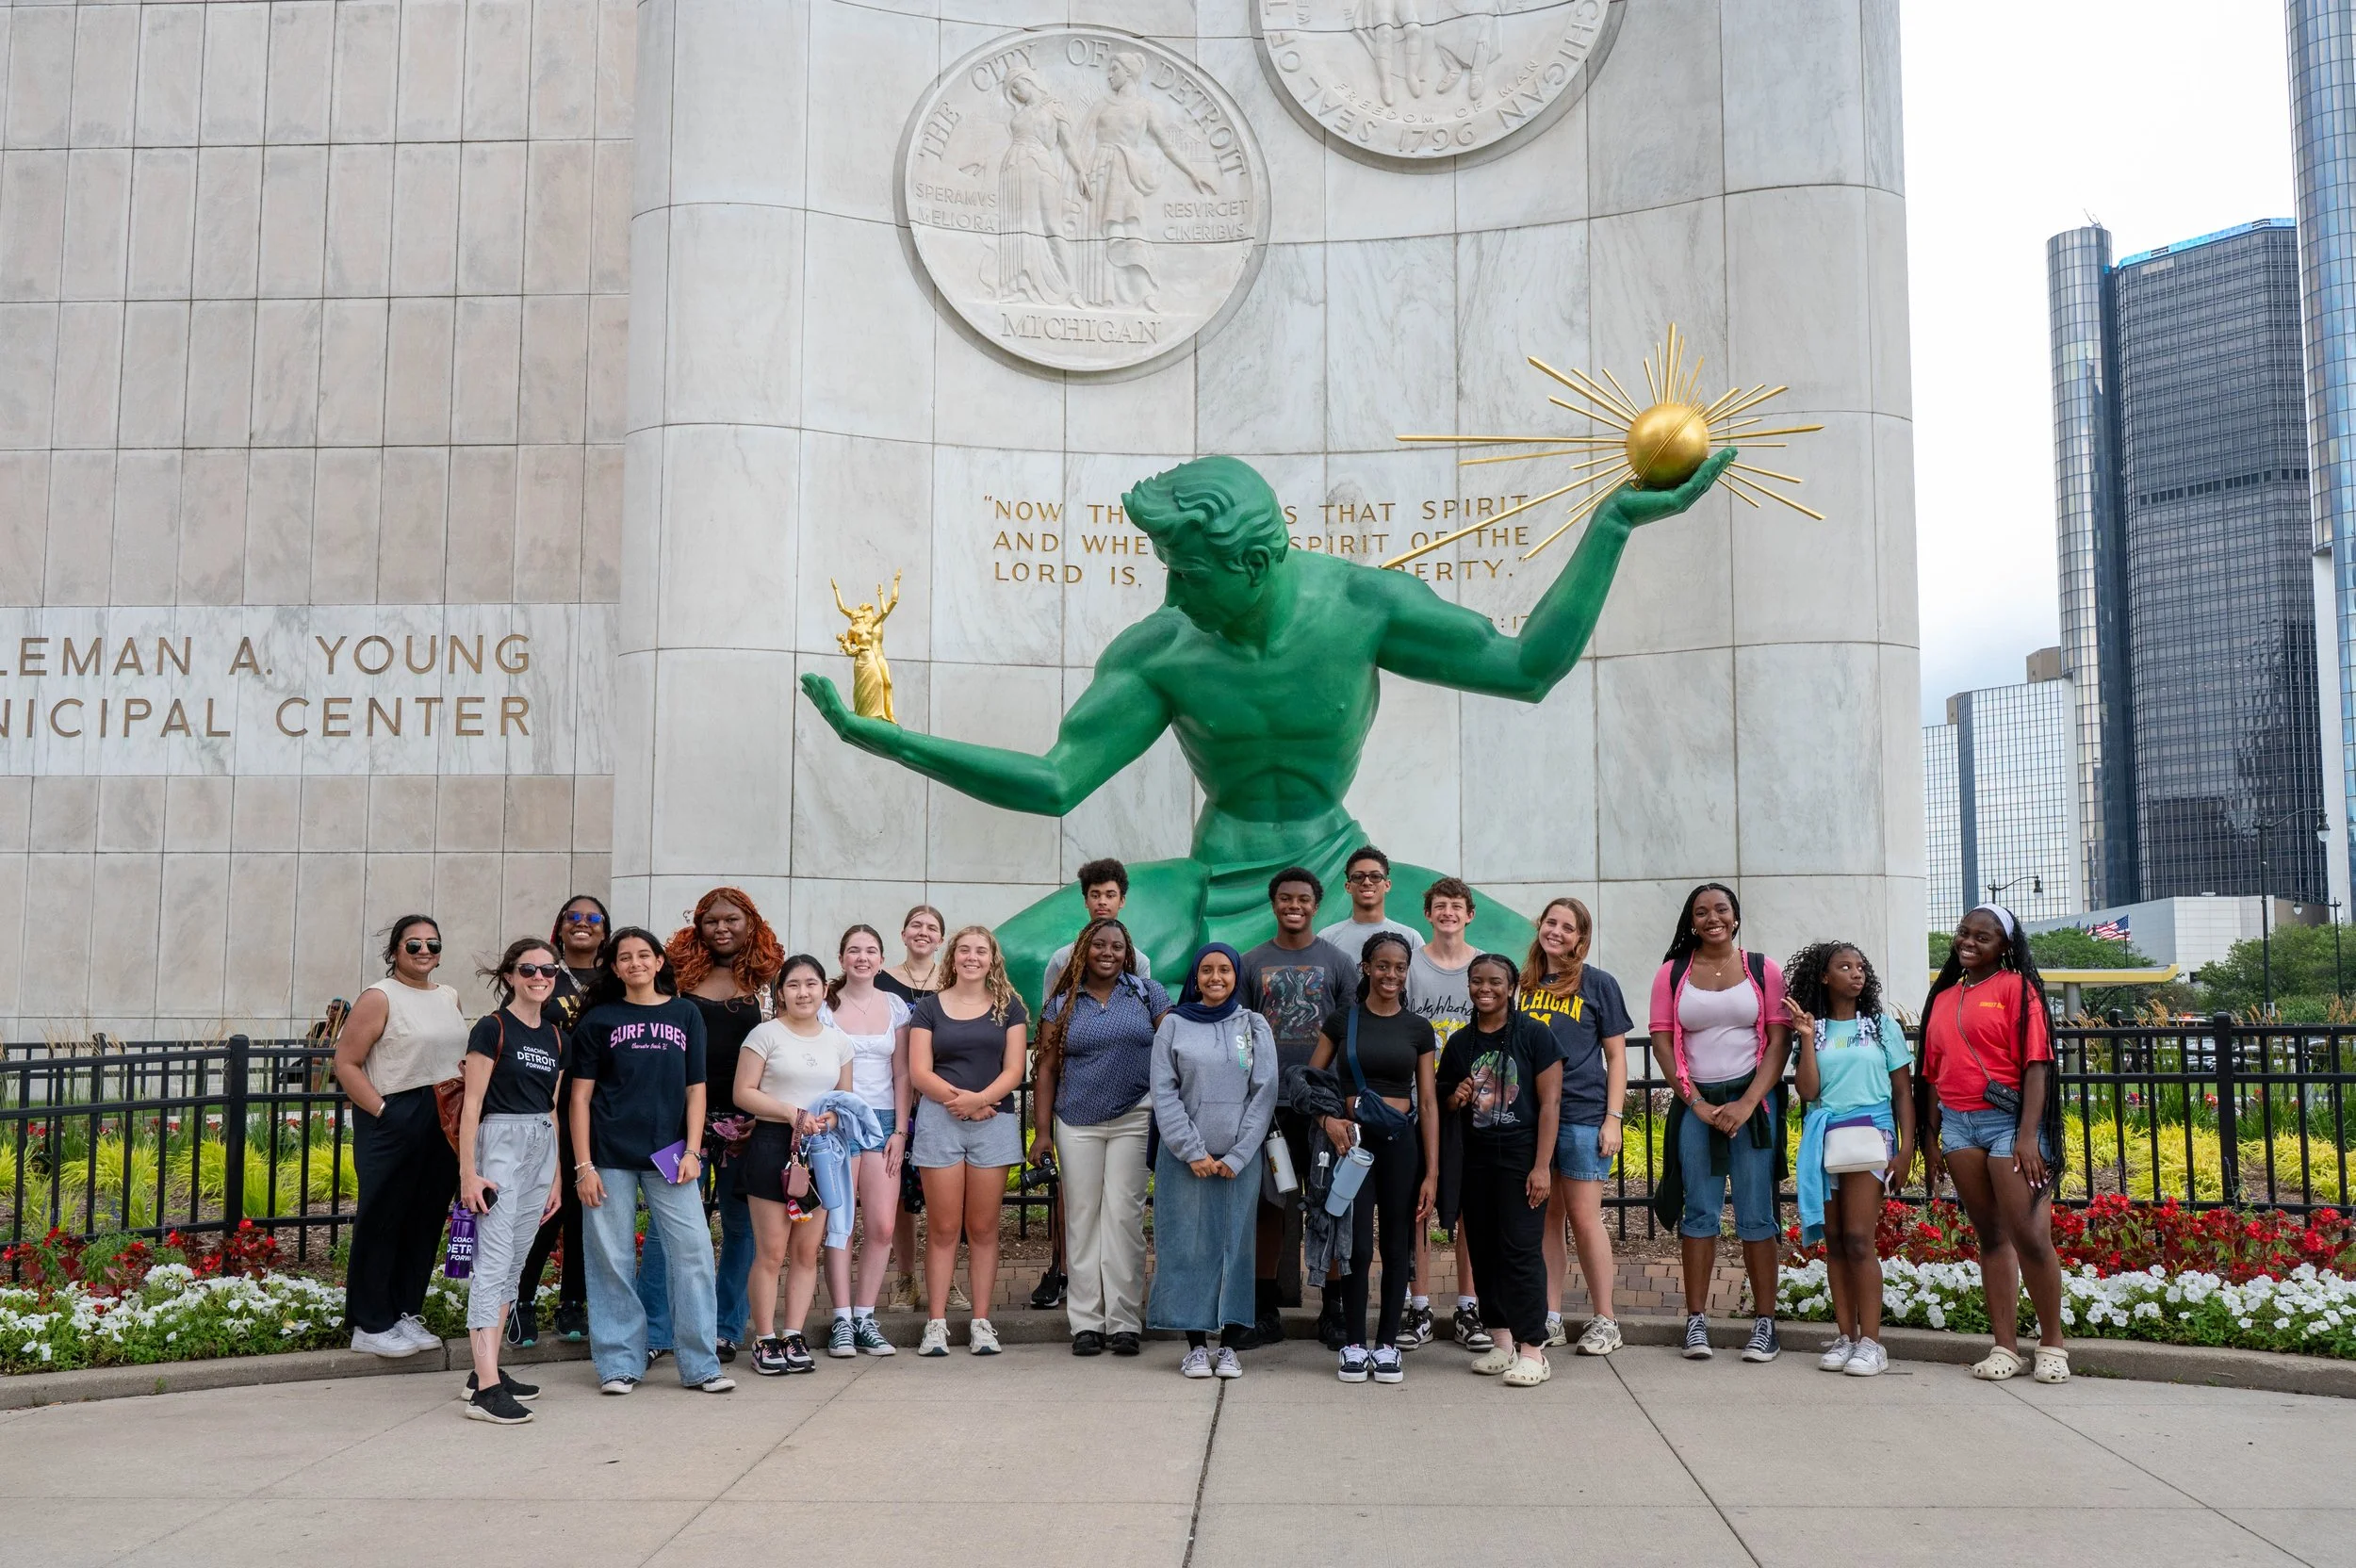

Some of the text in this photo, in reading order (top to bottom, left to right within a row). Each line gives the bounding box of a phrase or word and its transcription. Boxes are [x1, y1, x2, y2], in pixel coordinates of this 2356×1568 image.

[917, 38, 1247, 176] THE CITY OF DETROIT
[1333, 60, 1540, 124] FREEDOM OF MAN
[1302, 75, 1379, 143] SEAL
[1397, 122, 1478, 154] 1796
[915, 182, 996, 209] SPERAMVS
[918, 206, 995, 232] MELIORA
[1163, 222, 1246, 241] CINERIBVS
[1001, 313, 1162, 345] MICHIGAN
[1087, 504, 1124, 524] TH
[1283, 505, 1298, 525] S
[1318, 502, 1396, 525] THAT
[1421, 495, 1529, 520] SPIRIT
[992, 526, 1530, 555] AND WHE SPIRIT OF THE
[994, 562, 1083, 584] LORD
[1110, 566, 1142, 589] IS,
[228, 636, 274, 676] A.
[314, 633, 532, 676] YOUNG
[275, 696, 532, 738] CENTER
[1520, 989, 1584, 1024] CHIGAN
[610, 1021, 687, 1052] SURF VIBES
[516, 1051, 556, 1068] DETROIT
[525, 1062, 552, 1072] FORWARD
